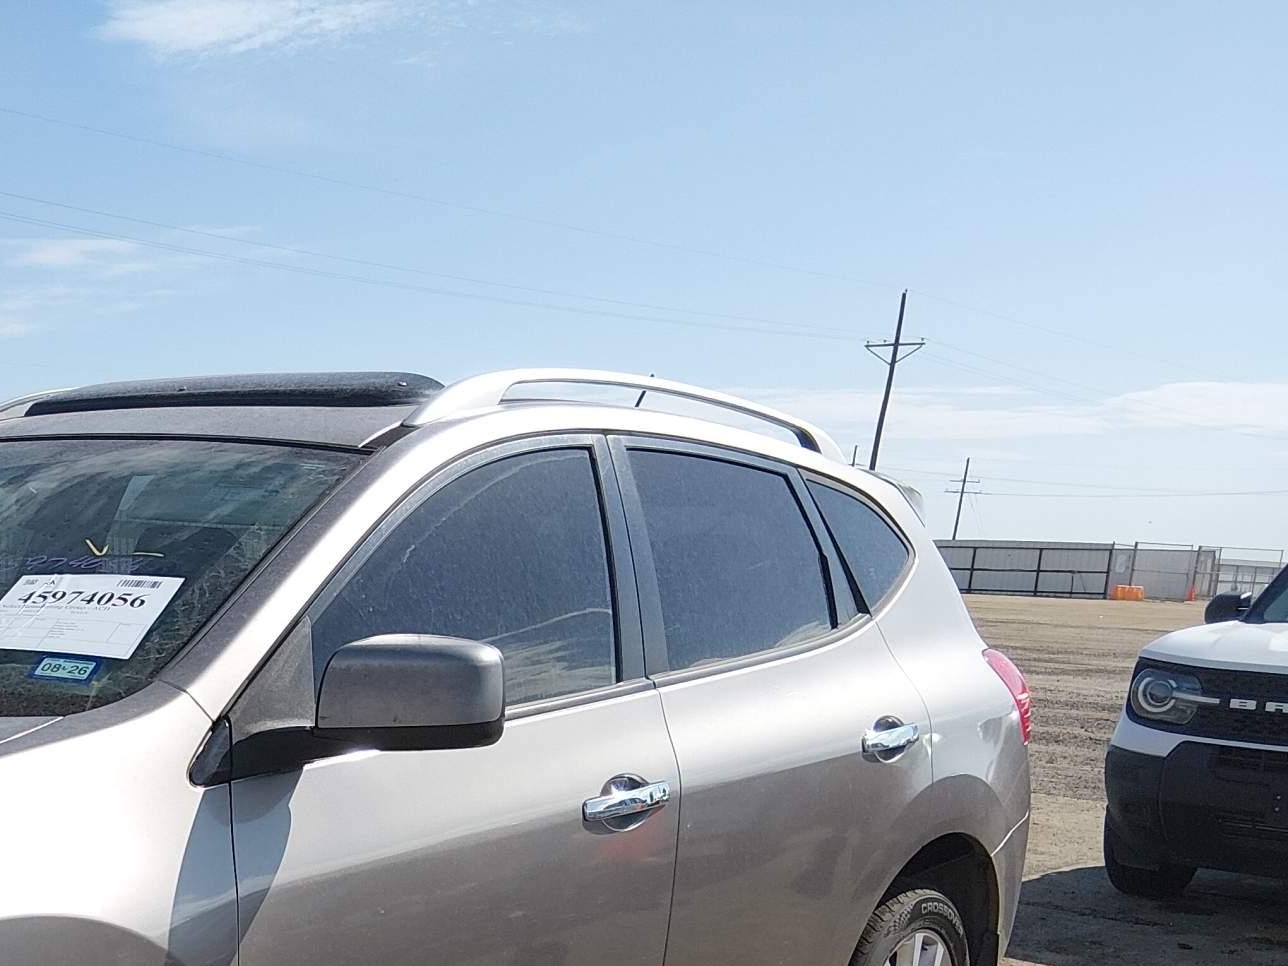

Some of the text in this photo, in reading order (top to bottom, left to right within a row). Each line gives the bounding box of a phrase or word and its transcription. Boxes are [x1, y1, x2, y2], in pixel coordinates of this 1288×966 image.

[17, 589, 152, 609] 45974056
[40, 662, 90, 676] 08 26
